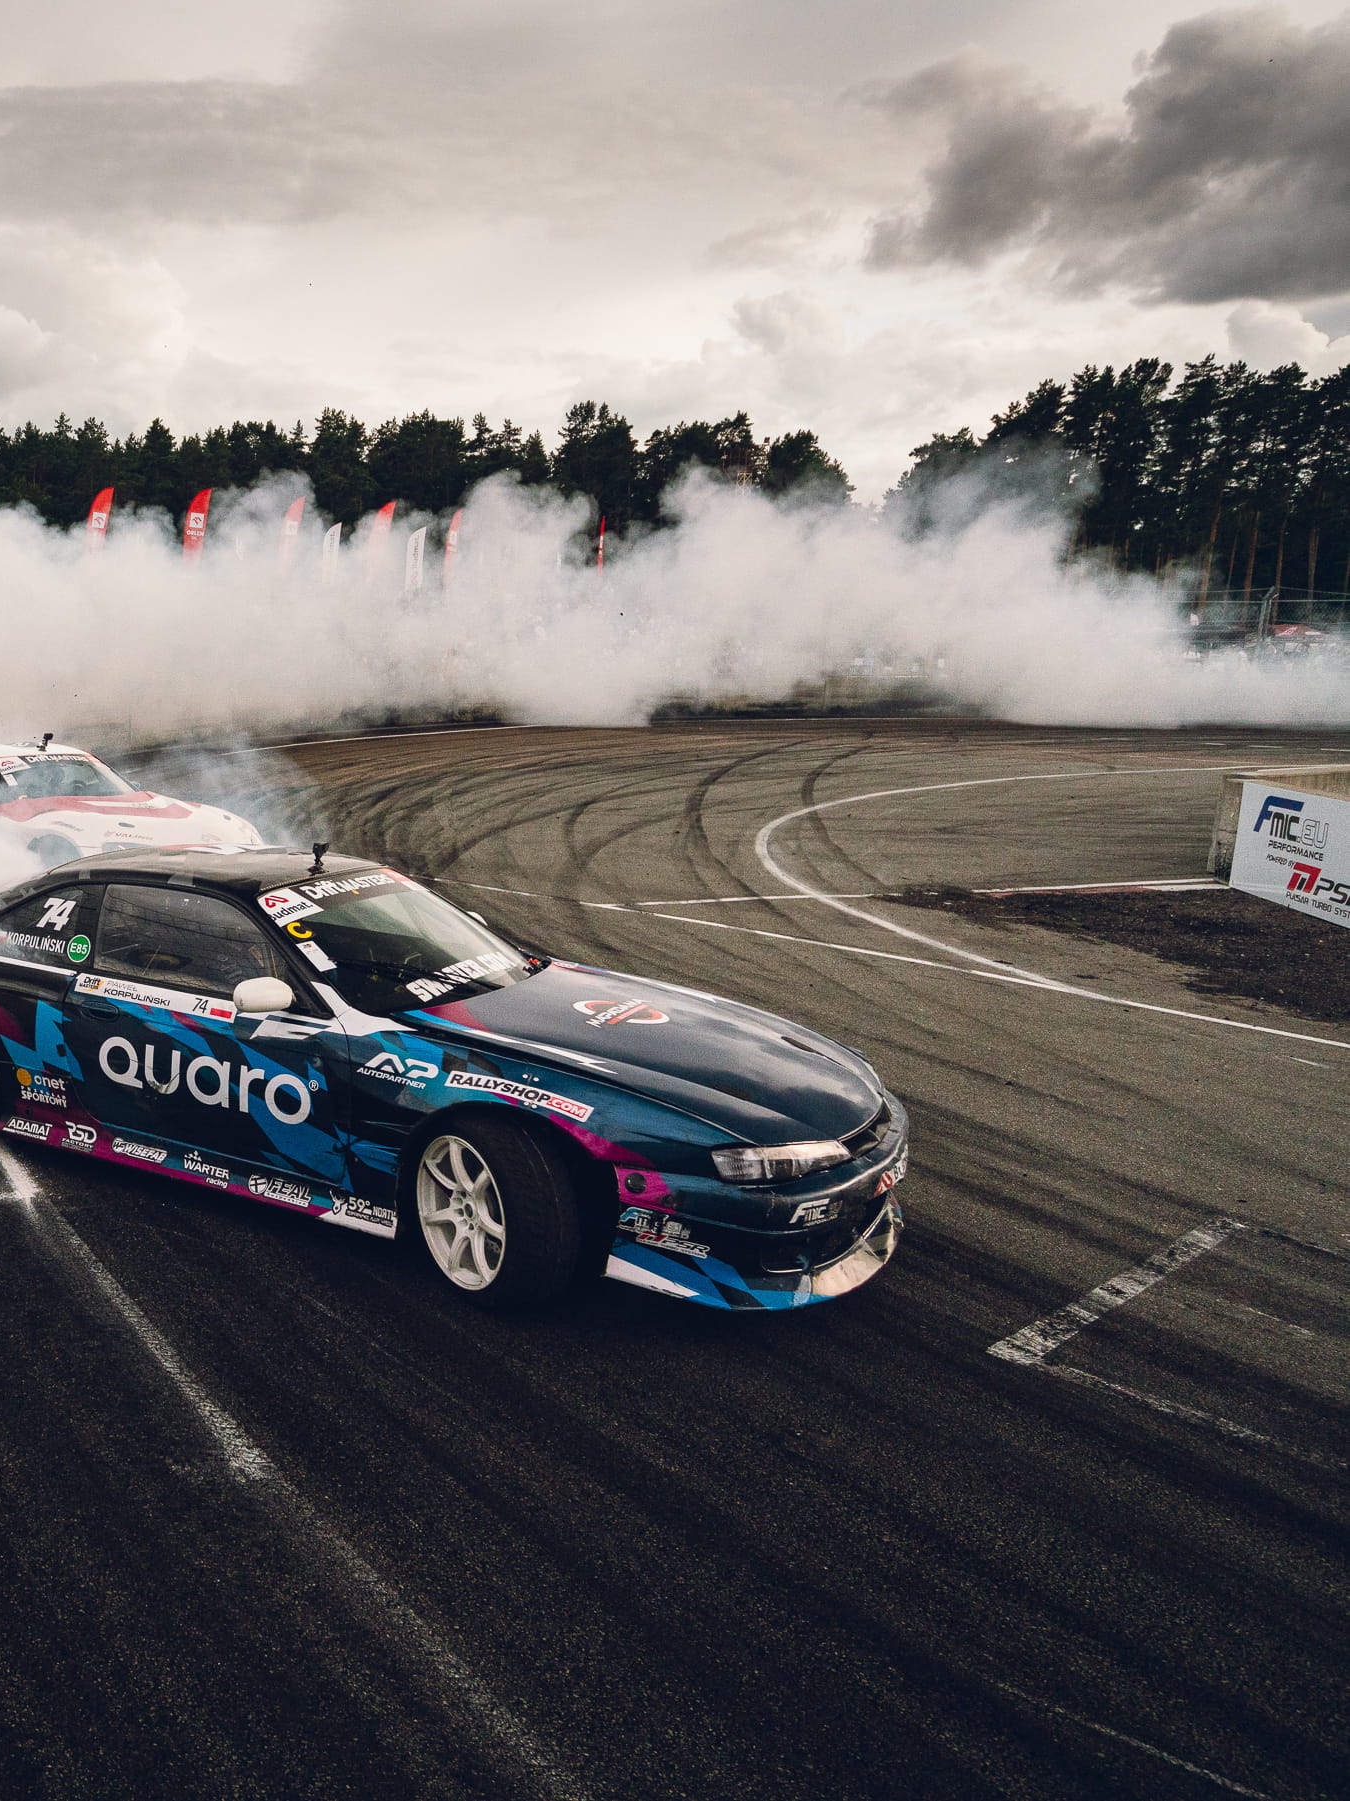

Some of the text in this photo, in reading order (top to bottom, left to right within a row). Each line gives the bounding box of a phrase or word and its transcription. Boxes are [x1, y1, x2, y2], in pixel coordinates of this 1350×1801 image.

[1266, 854, 1288, 866] POWERED
[1268, 840, 1324, 861] PERFORMANCE
[300, 879, 343, 899] Drift
[339, 874, 396, 894] MASTERS
[1286, 891, 1310, 904] PULSAR
[1312, 899, 1332, 912] TURBO
[36, 897, 76, 931] 74
[7, 931, 66, 953] KORPULIŃSKI
[70, 943, 88, 954] E85
[191, 997, 209, 1014] 74
[34, 1075, 66, 1091] onet
[356, 1067, 426, 1090] AUTOPARTNER
[20, 1090, 67, 1108] SPORTOWY
[8, 1118, 53, 1136] ADAMAT
[124, 1143, 167, 1162] WISEFAB
[183, 1158, 230, 1180] WARTER
[205, 1177, 228, 1189] racing
